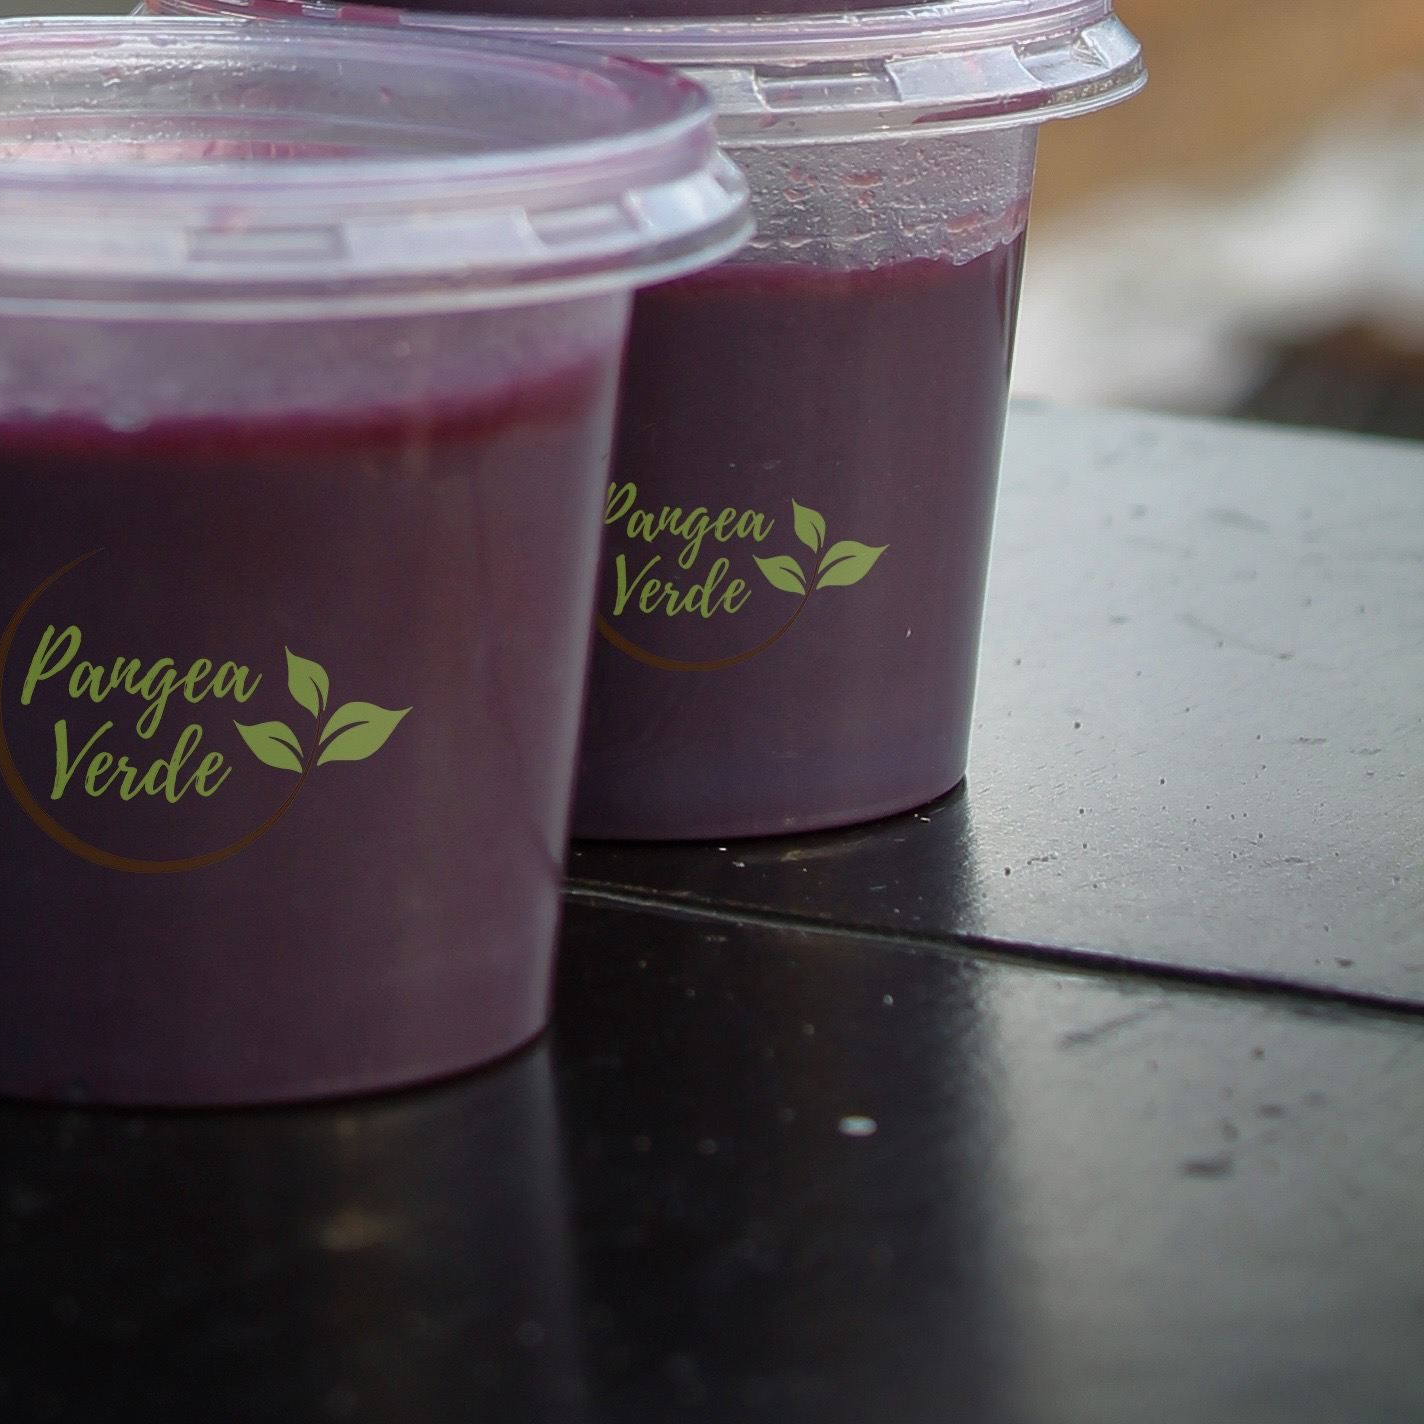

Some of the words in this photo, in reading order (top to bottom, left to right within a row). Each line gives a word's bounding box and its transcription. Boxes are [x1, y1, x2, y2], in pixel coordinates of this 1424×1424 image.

[603, 482, 774, 569] Pangea
[613, 554, 751, 618] Verde
[20, 625, 262, 739] Pangea
[51, 719, 231, 803] Verde
